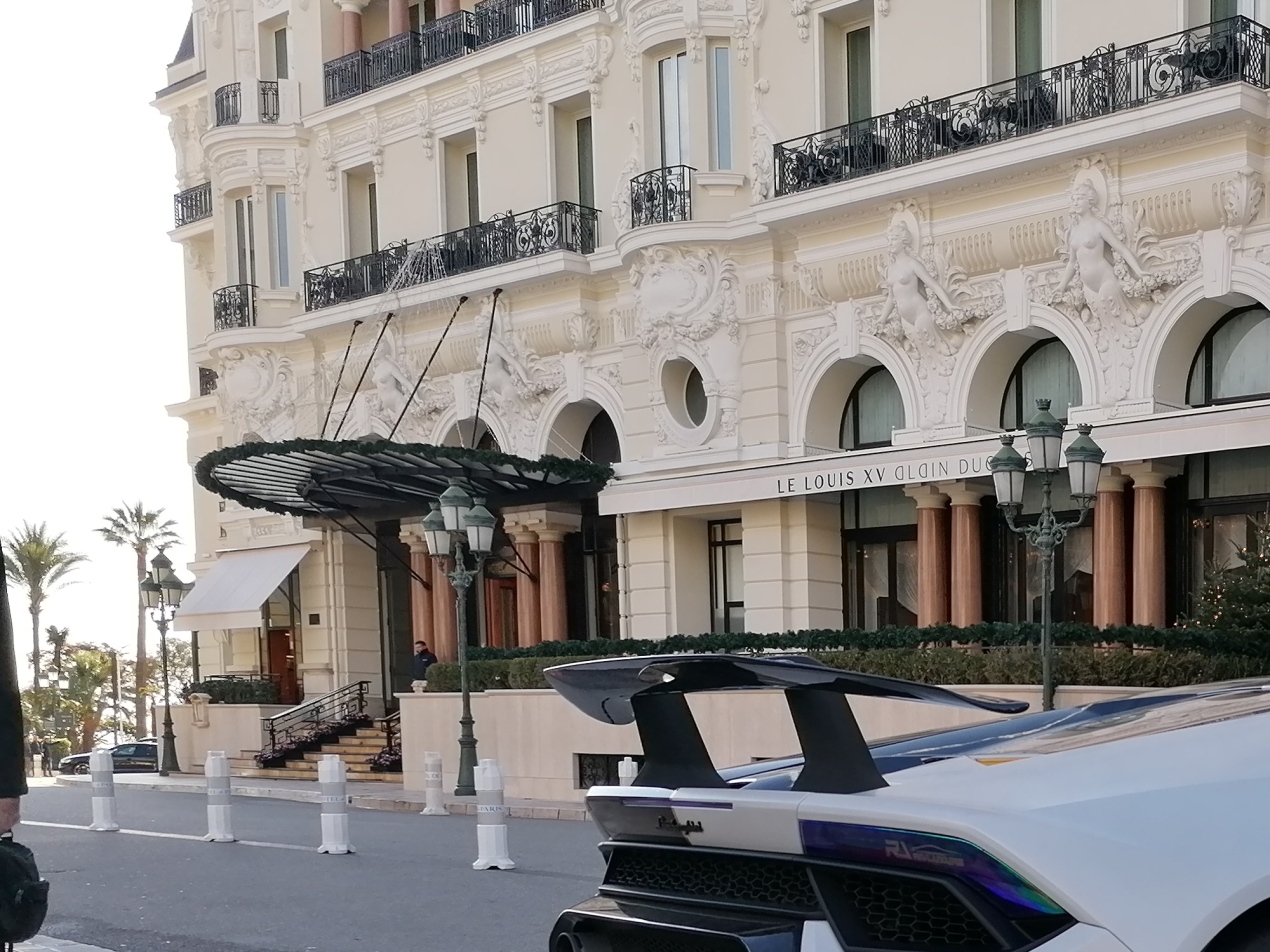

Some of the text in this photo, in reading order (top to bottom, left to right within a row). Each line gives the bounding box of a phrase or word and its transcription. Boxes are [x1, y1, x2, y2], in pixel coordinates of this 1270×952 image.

[777, 478, 795, 493] LE
[804, 471, 854, 491] LOUIS
[863, 467, 886, 484] XV
